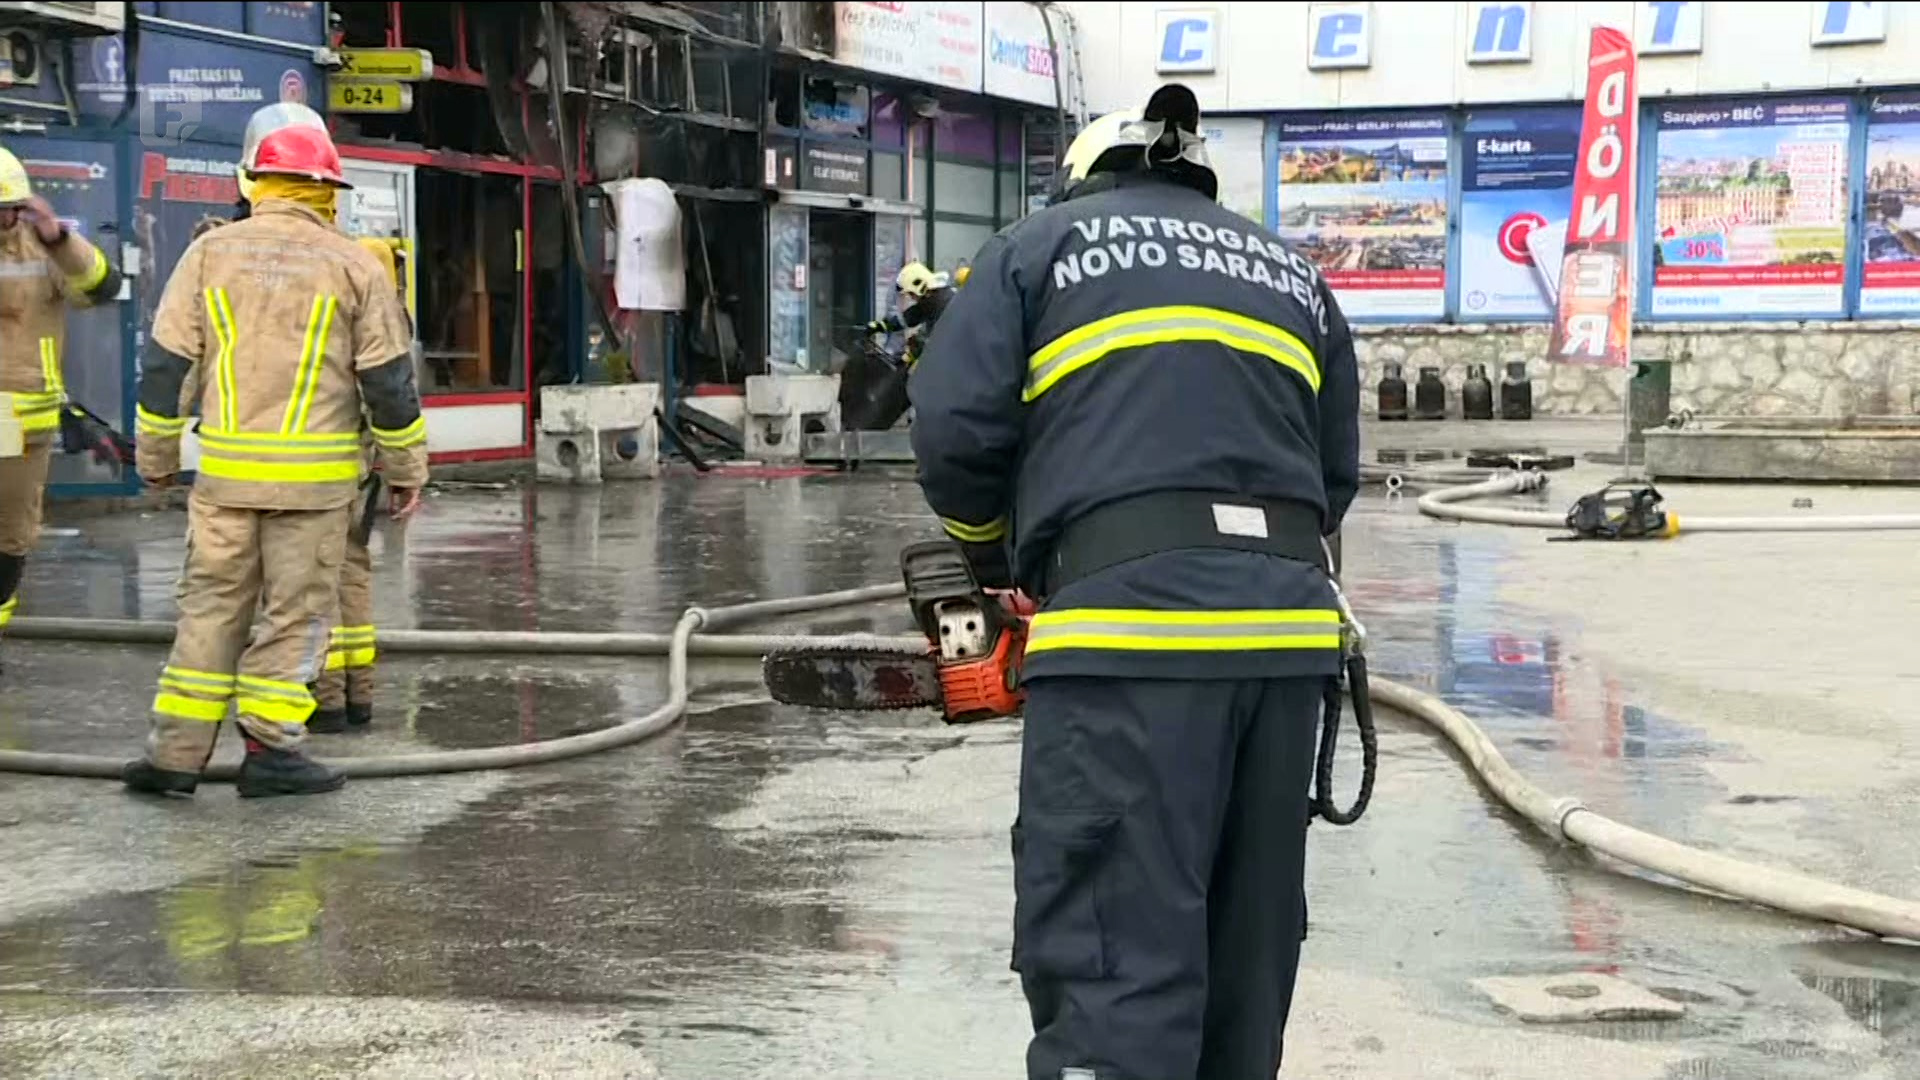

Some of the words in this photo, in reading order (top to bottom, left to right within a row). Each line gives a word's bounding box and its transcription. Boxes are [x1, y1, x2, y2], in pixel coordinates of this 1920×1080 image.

[344, 87, 383, 104] 0-24
[1664, 110, 1721, 125] Sarajevo
[1732, 105, 1764, 120] BEČ
[1476, 139, 1532, 155] E-karta
[1073, 215, 1318, 287] VATROGASCI
[1053, 241, 1168, 289] NOVO
